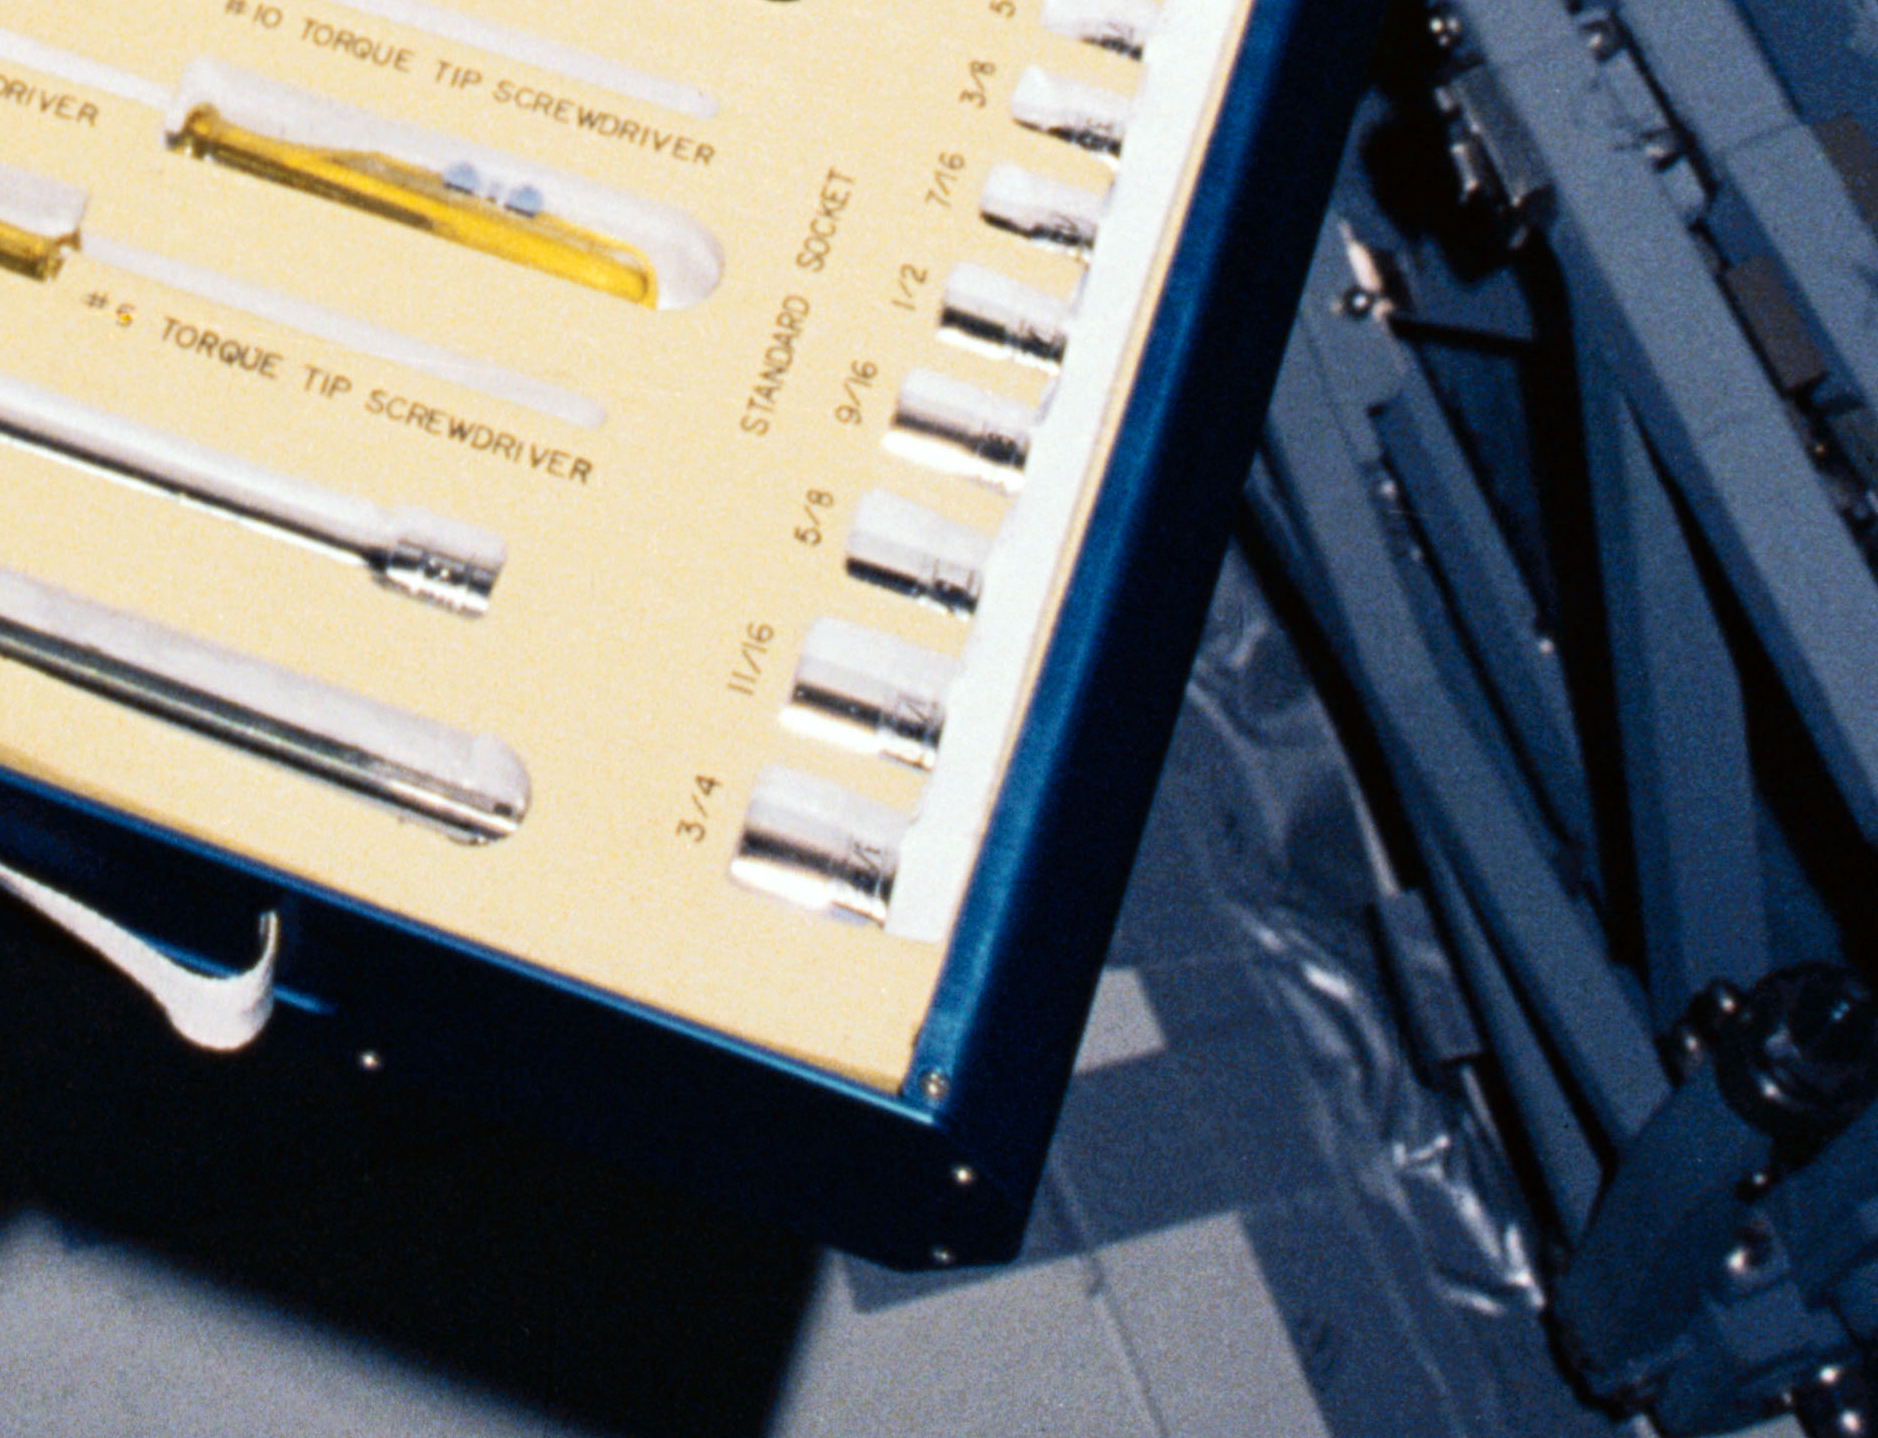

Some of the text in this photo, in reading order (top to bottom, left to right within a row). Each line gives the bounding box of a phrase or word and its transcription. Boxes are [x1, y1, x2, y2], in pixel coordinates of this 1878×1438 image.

[300, 16, 418, 74] TORQUE
[433, 59, 484, 91] TIP
[491, 78, 717, 170] SCREWDRIVER
[958, 59, 998, 109] 3/8
[924, 150, 967, 210] 7/16
[739, 164, 858, 439] STANDARD SOCKET
[890, 262, 930, 313] 1/2
[160, 314, 286, 382] TORQUE
[302, 363, 354, 398] TIP
[362, 391, 596, 486] SCREWDRIVER
[833, 358, 881, 428] 9/16
[792, 486, 837, 549] 5/8
[726, 621, 777, 698] 11/16
[675, 770, 724, 844] 3/4
